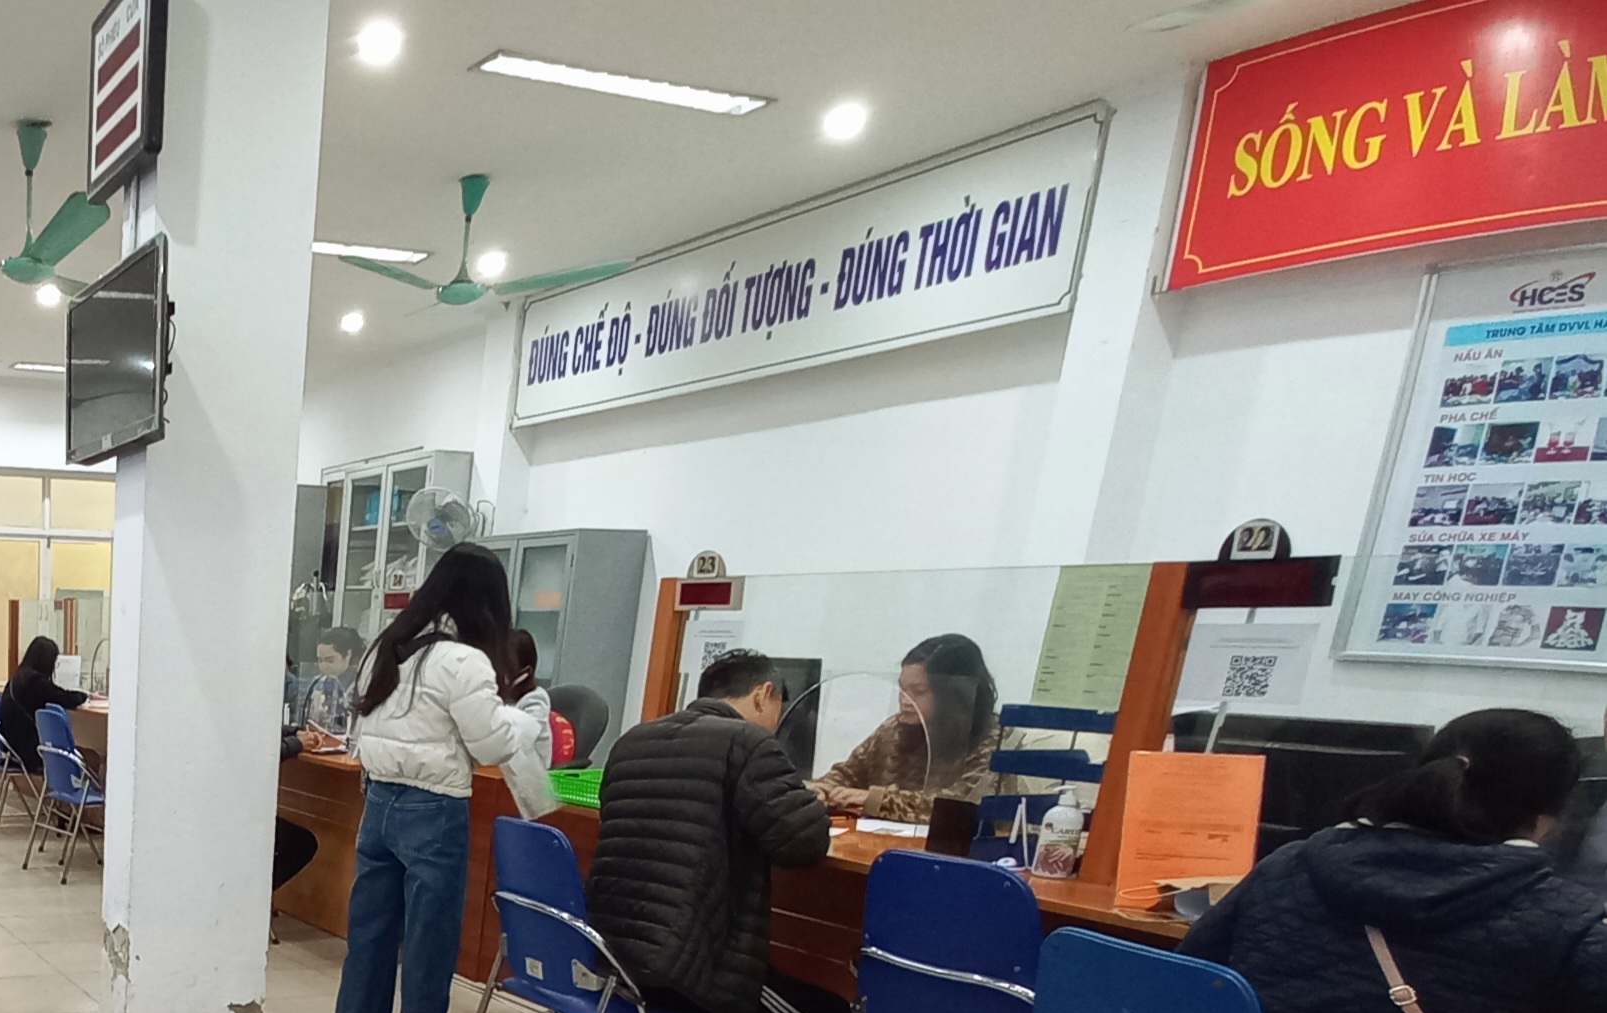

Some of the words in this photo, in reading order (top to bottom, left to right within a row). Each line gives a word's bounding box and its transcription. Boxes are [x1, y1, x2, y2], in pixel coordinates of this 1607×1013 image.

[1227, 101, 1388, 199] SỐNG
[1403, 59, 1481, 158] VÀ
[527, 326, 570, 386] ĐÚNG
[572, 302, 609, 376] CHẾ
[605, 301, 632, 376] ĐỘ
[645, 289, 698, 358] ĐÚNG
[700, 261, 740, 344] ĐỐI
[741, 258, 816, 340] TƯỢNG
[833, 227, 910, 311] ĐÚNG
[914, 195, 983, 291] THỜI
[984, 183, 1070, 274] GIAN
[1517, 283, 1586, 307] HCES
[1486, 326, 1526, 339] TRUNG
[1530, 322, 1555, 335] TÂM
[1558, 320, 1591, 333] DVVL
[1454, 348, 1481, 362] NẤU
[1484, 348, 1504, 359] ĂN
[1439, 413, 1466, 423] PHA
[1469, 407, 1500, 421] CHẾ
[1424, 474, 1445, 483] TIN
[1240, 526, 1273, 552] 22
[1478, 532, 1496, 541] XE
[1499, 530, 1530, 541] MÁY
[697, 556, 716, 574] 23
[1393, 592, 1419, 601] MAY
[1423, 591, 1461, 602] CÔNG
